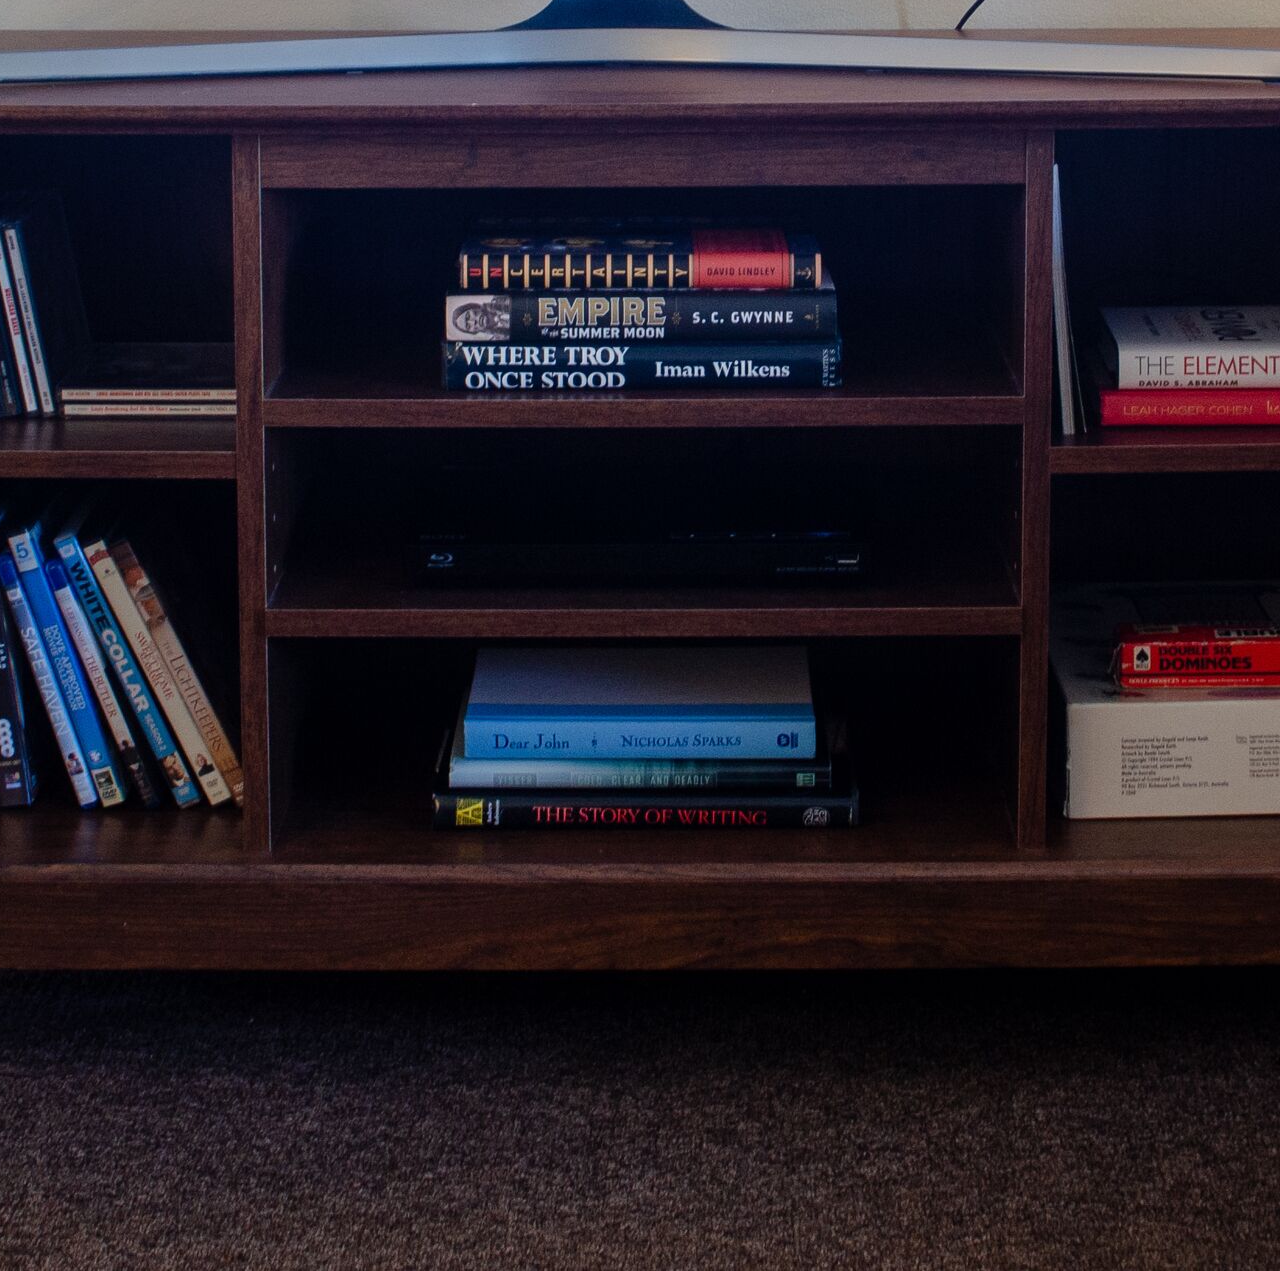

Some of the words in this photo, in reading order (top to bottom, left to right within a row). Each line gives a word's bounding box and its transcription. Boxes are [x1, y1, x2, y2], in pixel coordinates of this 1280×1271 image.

[706, 267, 735, 276] DAVID
[738, 267, 776, 276] LINDLEY
[537, 297, 667, 327] EMPIRE
[692, 311, 706, 324] S.
[710, 311, 724, 324] C.
[730, 310, 794, 324] GWYNNE
[560, 327, 620, 339] SUMMER
[624, 327, 665, 339] MOON
[462, 346, 557, 366] WHERE
[564, 346, 629, 366] TROY
[654, 361, 706, 378] Iman
[712, 359, 791, 378] Wilkens
[1134, 355, 1175, 376] THE
[465, 371, 534, 389] ONCE
[541, 371, 626, 389] STOOD
[1187, 379, 1239, 387] ABRAHAM
[1123, 404, 1158, 416] LEAH
[1162, 404, 1204, 416] HAGER
[1207, 404, 1254, 416] COHEN
[16, 542, 29, 559] 5
[69, 561, 112, 630] WHITE
[101, 628, 151, 713] COLLAR
[1158, 646, 1209, 656] DOUBLE
[1213, 645, 1233, 655] SIX
[43, 627, 59, 657] MOVIE
[54, 656, 78, 711] COLLECTION
[1159, 655, 1253, 671] DOMINOES
[20, 627, 46, 673] SAFE
[38, 675, 67, 736] HAVEN
[86, 655, 99, 673] THE
[93, 672, 118, 718] BUTLER
[153, 663, 175, 701] HOME
[169, 654, 223, 753] LIGHTKEEPERS
[493, 733, 530, 750] Dear
[533, 733, 570, 750] John
[611, 774, 641, 785] CLEAR
[650, 775, 669, 785] AND
[674, 774, 710, 785] DEADLY
[532, 805, 574, 824] THE
[578, 805, 640, 825] STORY
[644, 807, 673, 825] OF
[677, 808, 768, 826] WRITING
